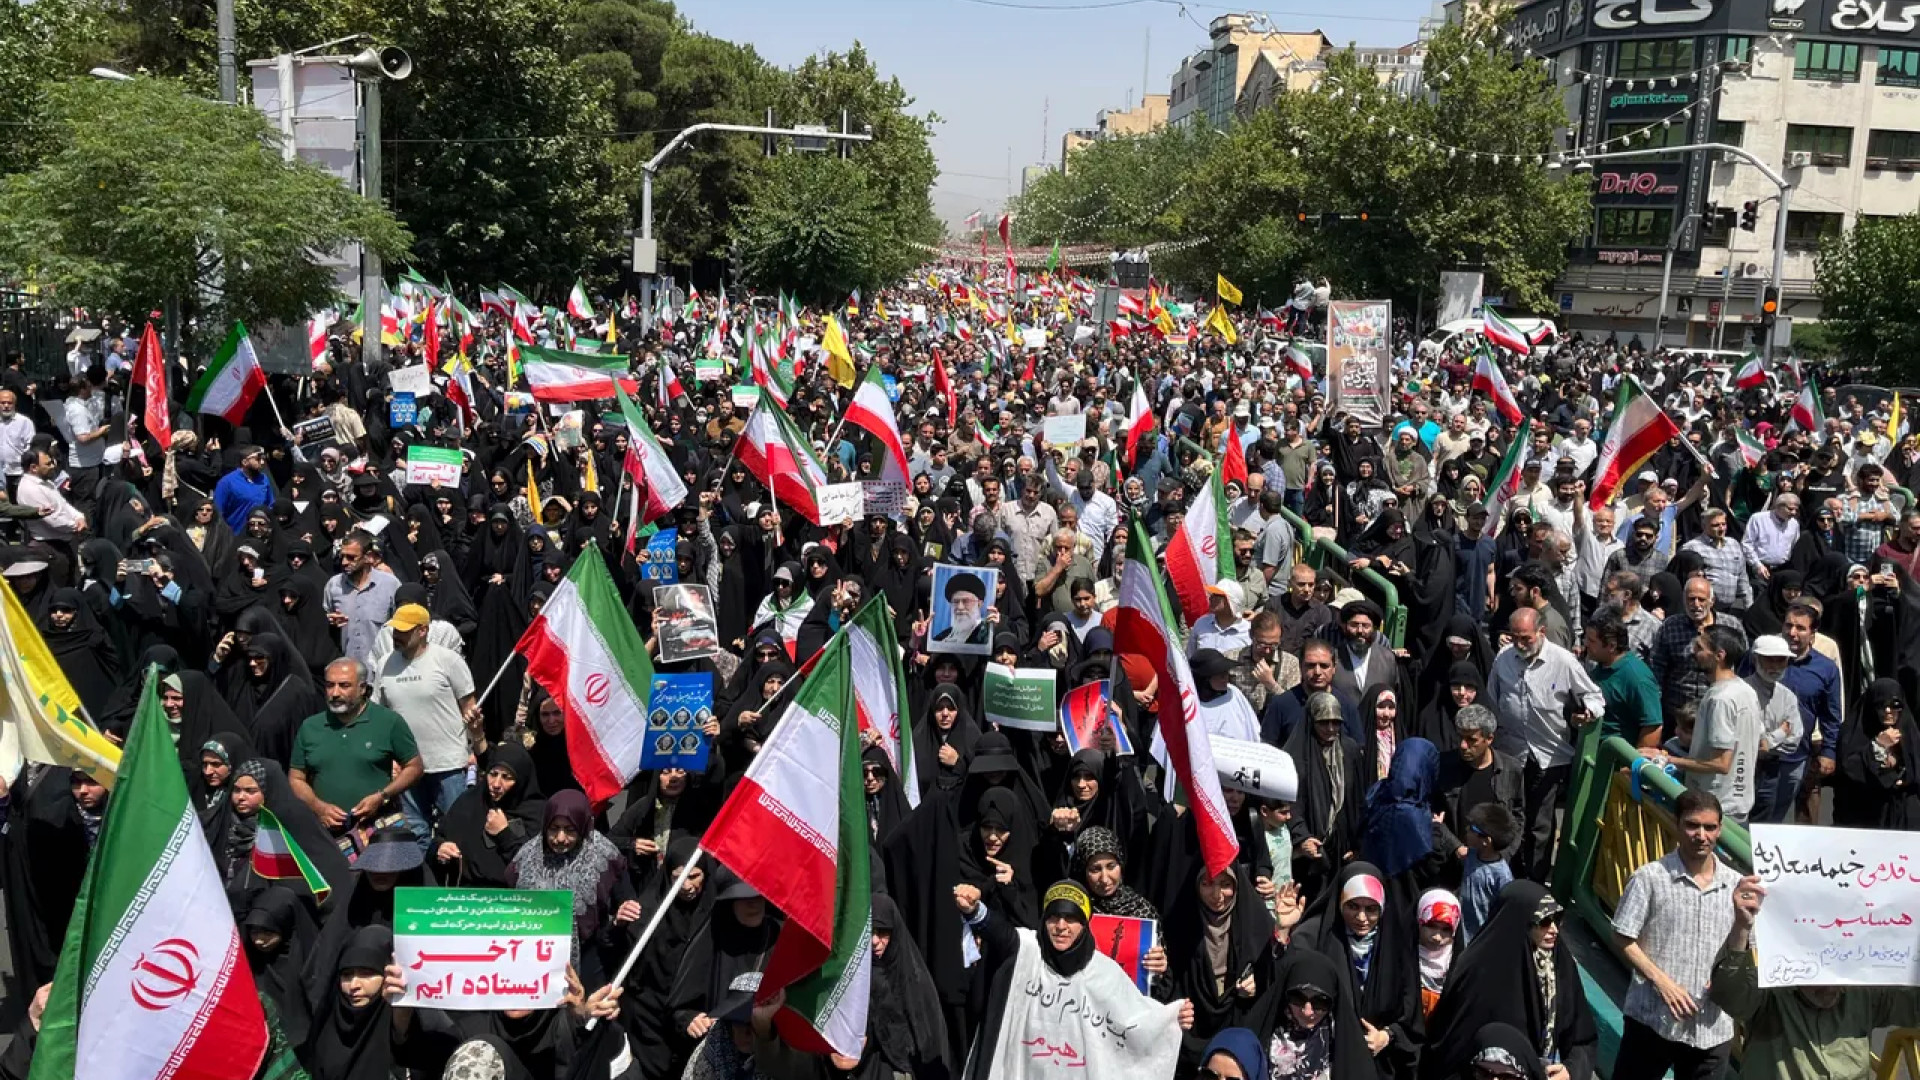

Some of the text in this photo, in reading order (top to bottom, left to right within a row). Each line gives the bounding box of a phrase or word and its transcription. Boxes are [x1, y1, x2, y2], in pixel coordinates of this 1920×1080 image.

[1610, 92, 1688, 108] gajmarket.com
[410, 939, 555, 970] تا آخر
[416, 972, 550, 1001] ایستاده ایم
[1021, 1036, 1087, 1067] رهبرم
